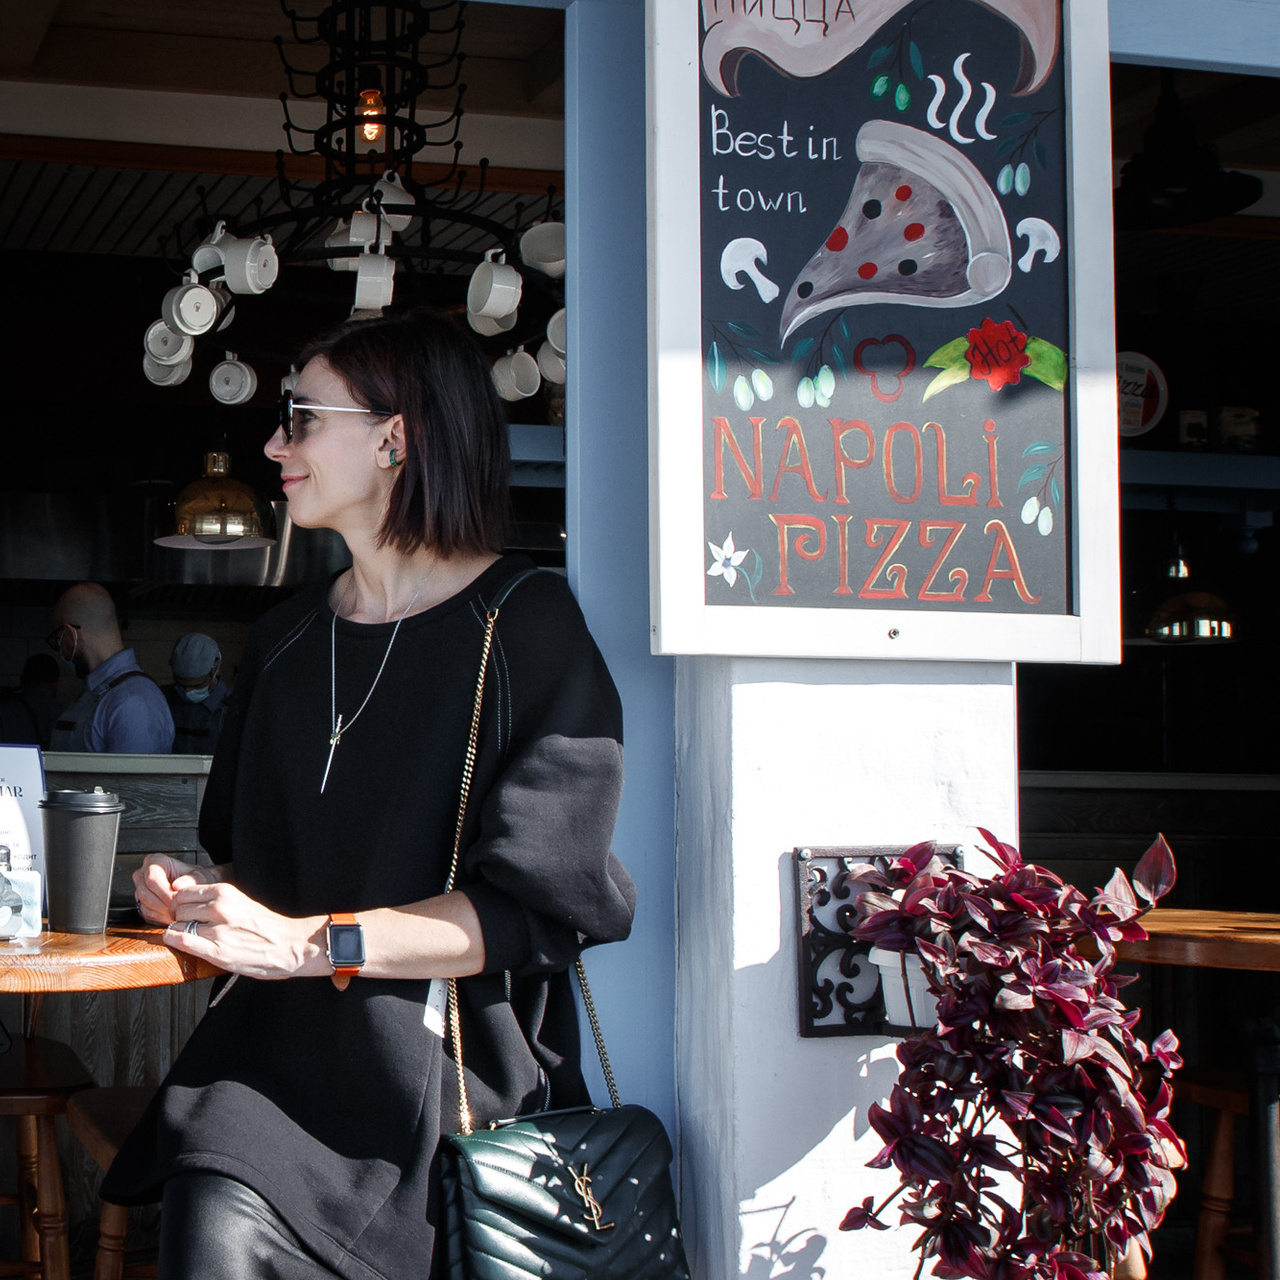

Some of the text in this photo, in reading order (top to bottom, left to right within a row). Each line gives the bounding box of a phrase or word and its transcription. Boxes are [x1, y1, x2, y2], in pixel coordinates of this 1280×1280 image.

[711, 103, 843, 161] Best in
[710, 174, 808, 214] town
[767, 512, 1043, 605] PIZZA
